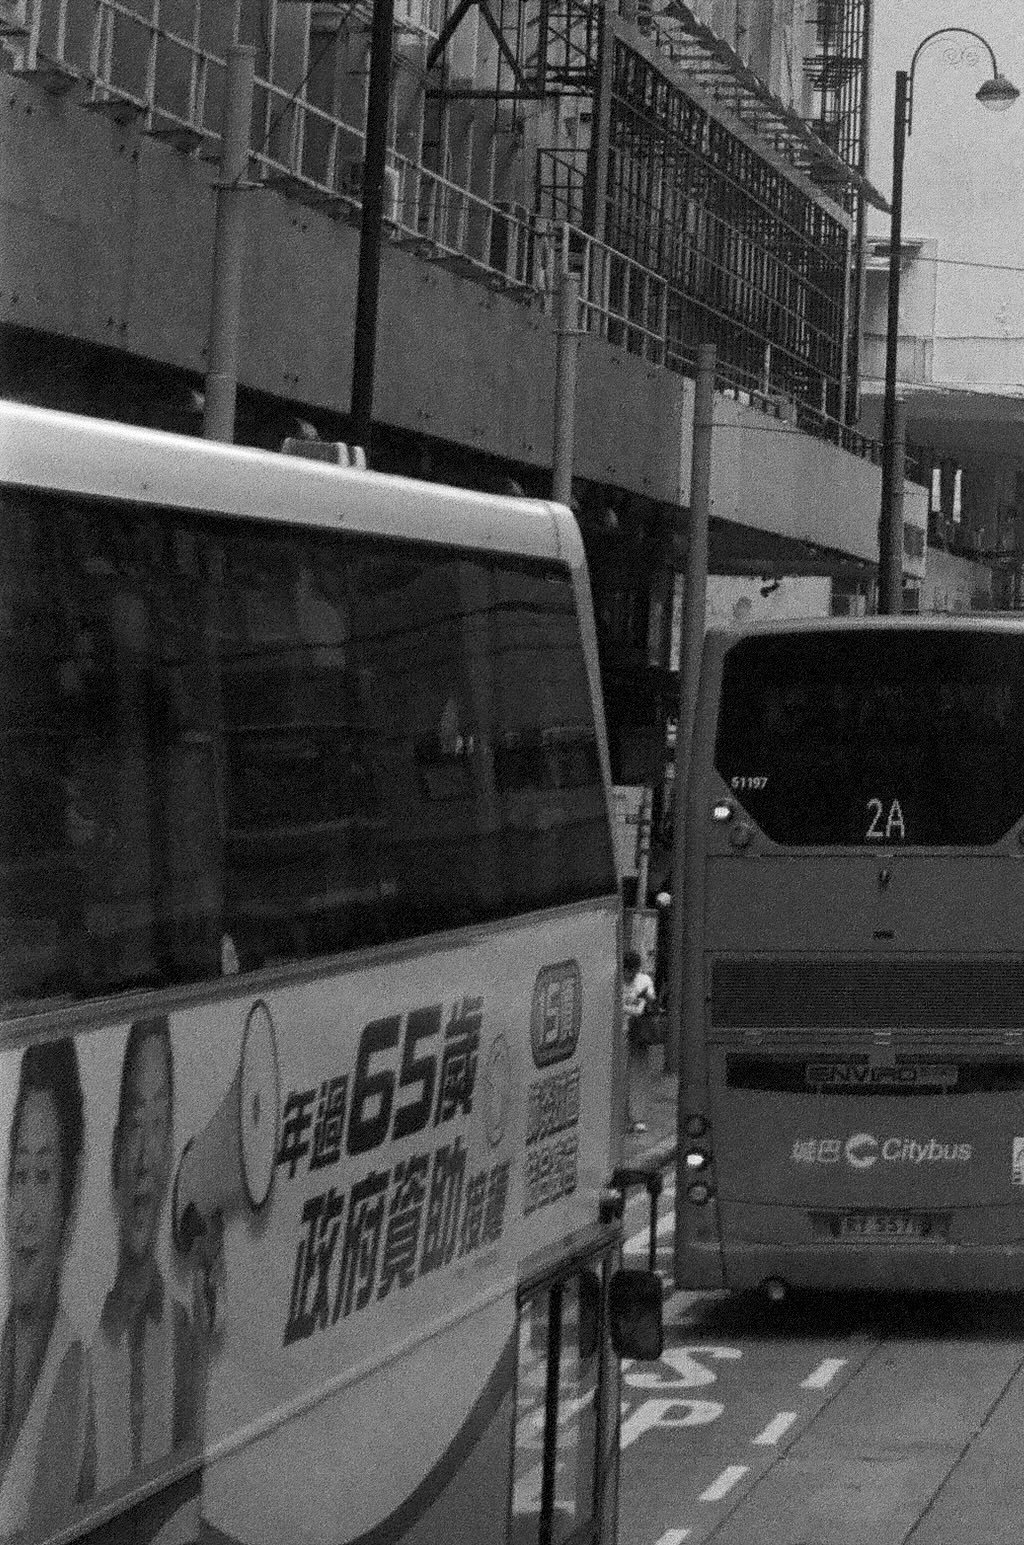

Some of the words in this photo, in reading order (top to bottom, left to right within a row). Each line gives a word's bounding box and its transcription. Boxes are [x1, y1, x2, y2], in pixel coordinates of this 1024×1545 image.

[865, 798, 906, 839] 2A
[790, 1138, 842, 1163] 城巴
[883, 1136, 974, 1165] Citybus
